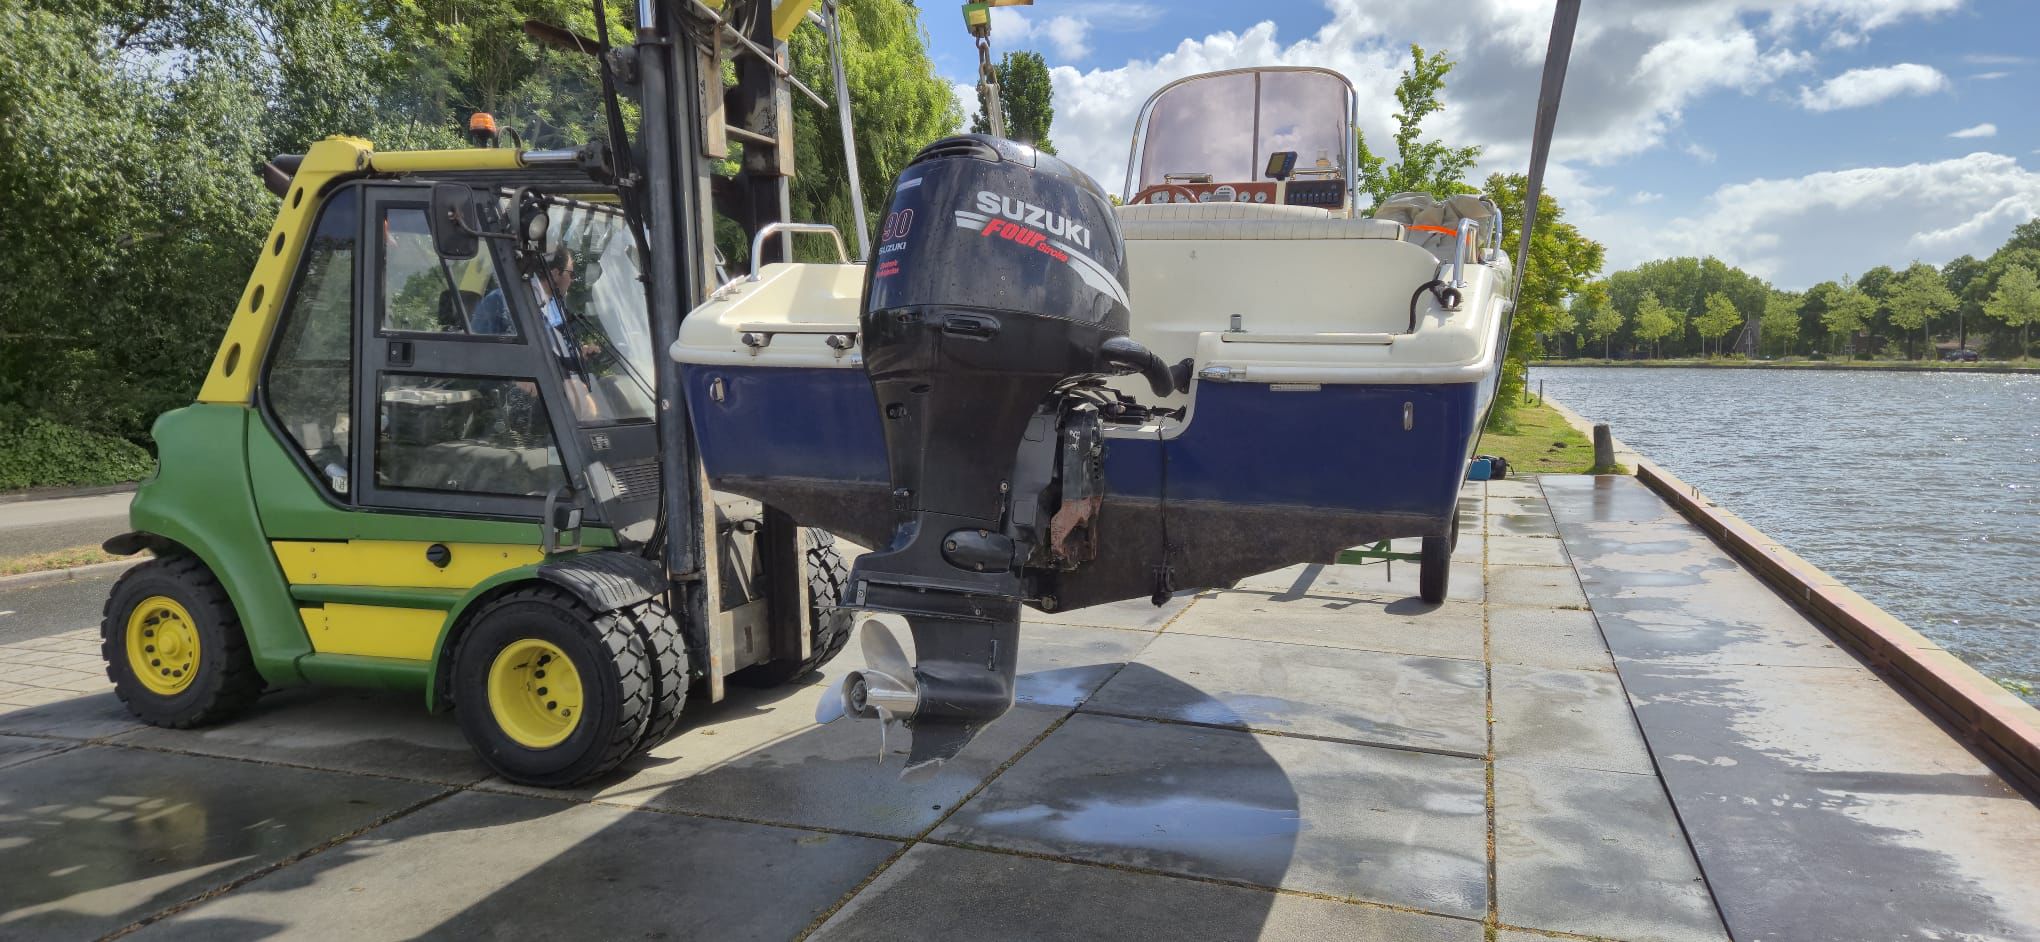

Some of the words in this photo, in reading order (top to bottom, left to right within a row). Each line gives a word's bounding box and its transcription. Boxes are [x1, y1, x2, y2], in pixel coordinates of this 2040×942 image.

[882, 208, 914, 242] 90
[976, 190, 1090, 250] SUZUKI
[879, 241, 907, 256] SUZUKI
